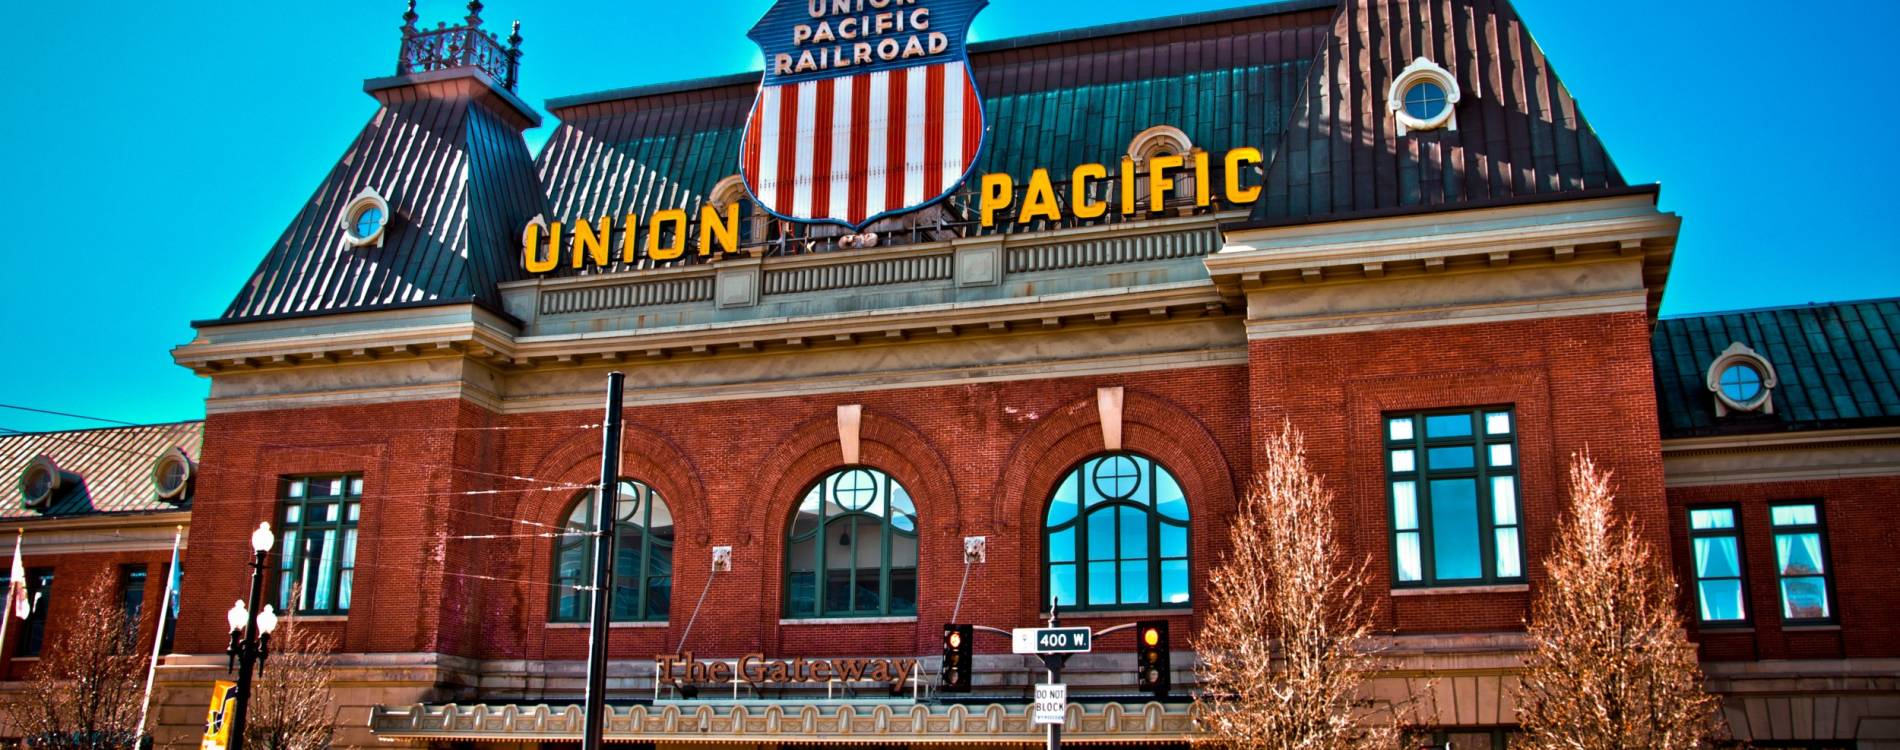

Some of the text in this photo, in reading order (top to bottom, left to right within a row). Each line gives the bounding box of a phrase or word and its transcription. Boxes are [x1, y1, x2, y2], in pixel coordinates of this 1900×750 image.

[808, 0, 915, 18] UNI
[793, 8, 930, 46] PACIFIC
[774, 31, 949, 75] RAILROAD
[525, 147, 1263, 273] UNION PACIFIC
[1040, 633, 1087, 647] 400 W.
[656, 651, 917, 691] The Gateway
[1036, 690, 1064, 699] DO NOT
[1036, 702, 1064, 712] BLOCK
